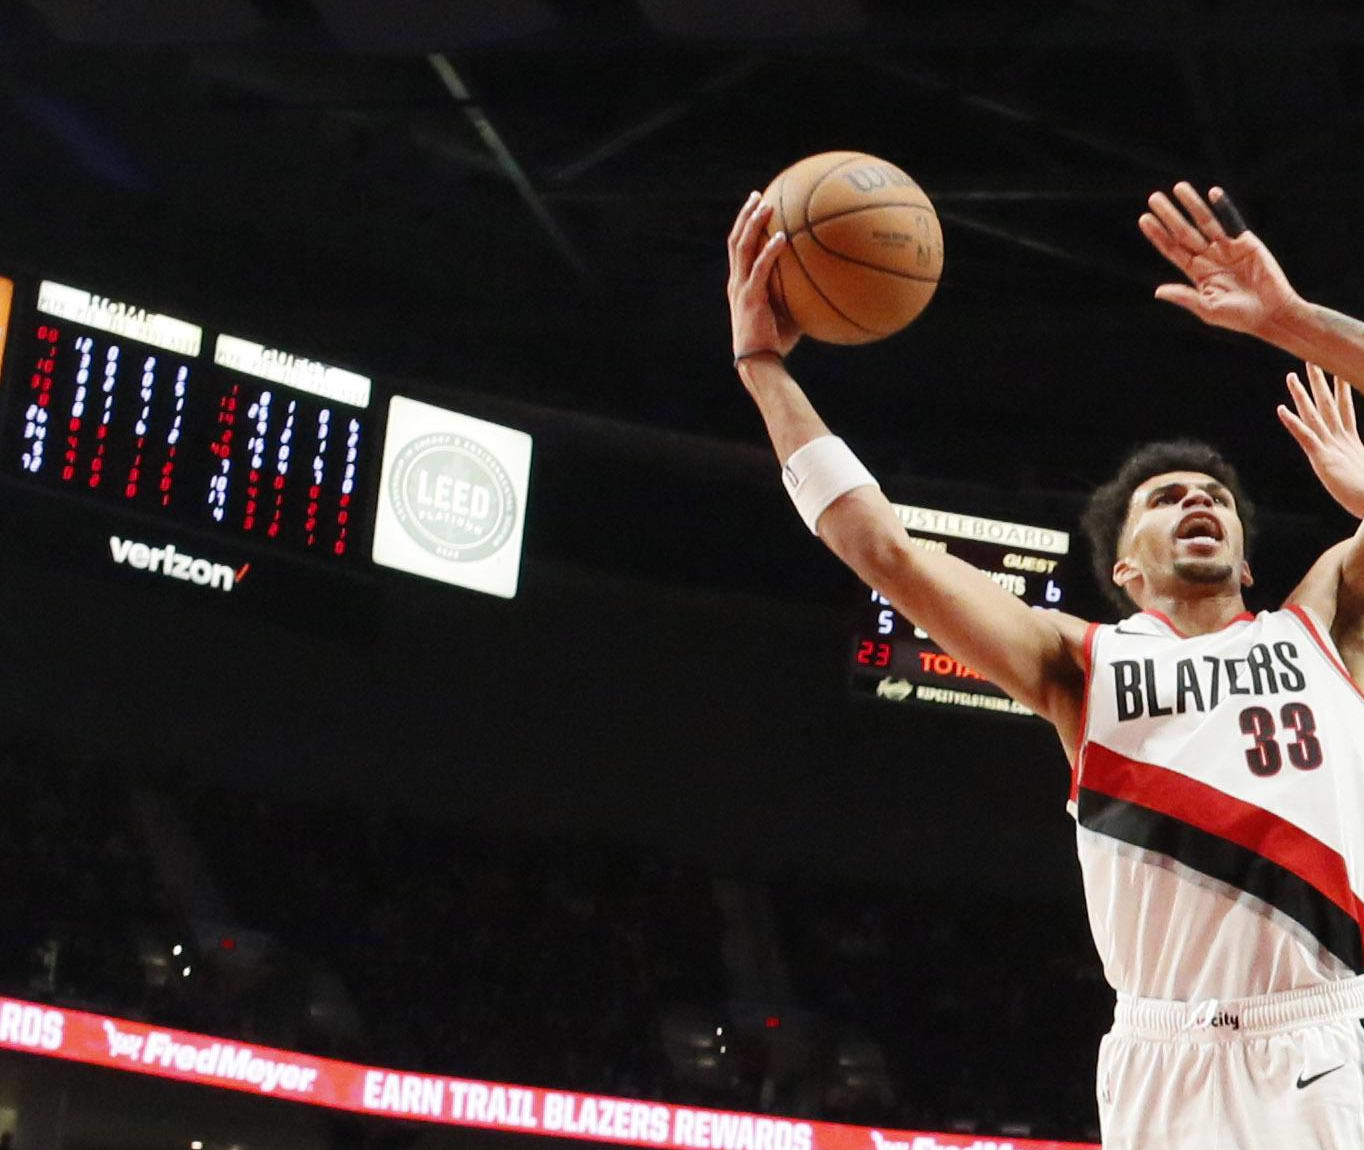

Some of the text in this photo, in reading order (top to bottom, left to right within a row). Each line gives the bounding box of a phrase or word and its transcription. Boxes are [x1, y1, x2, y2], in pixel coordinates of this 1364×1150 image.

[417, 469, 490, 520] LEED
[109, 536, 236, 591] verizon
[1003, 553, 1058, 573] GUEST
[1045, 580, 1061, 602] 6
[877, 610, 894, 634] 5
[857, 640, 891, 666] 23
[1110, 641, 1306, 722] BLAZERS
[1239, 701, 1325, 778] 33
[363, 1070, 443, 1116] EARN
[450, 1080, 537, 1128] TRAIL
[543, 1092, 670, 1142] BLAZERS
